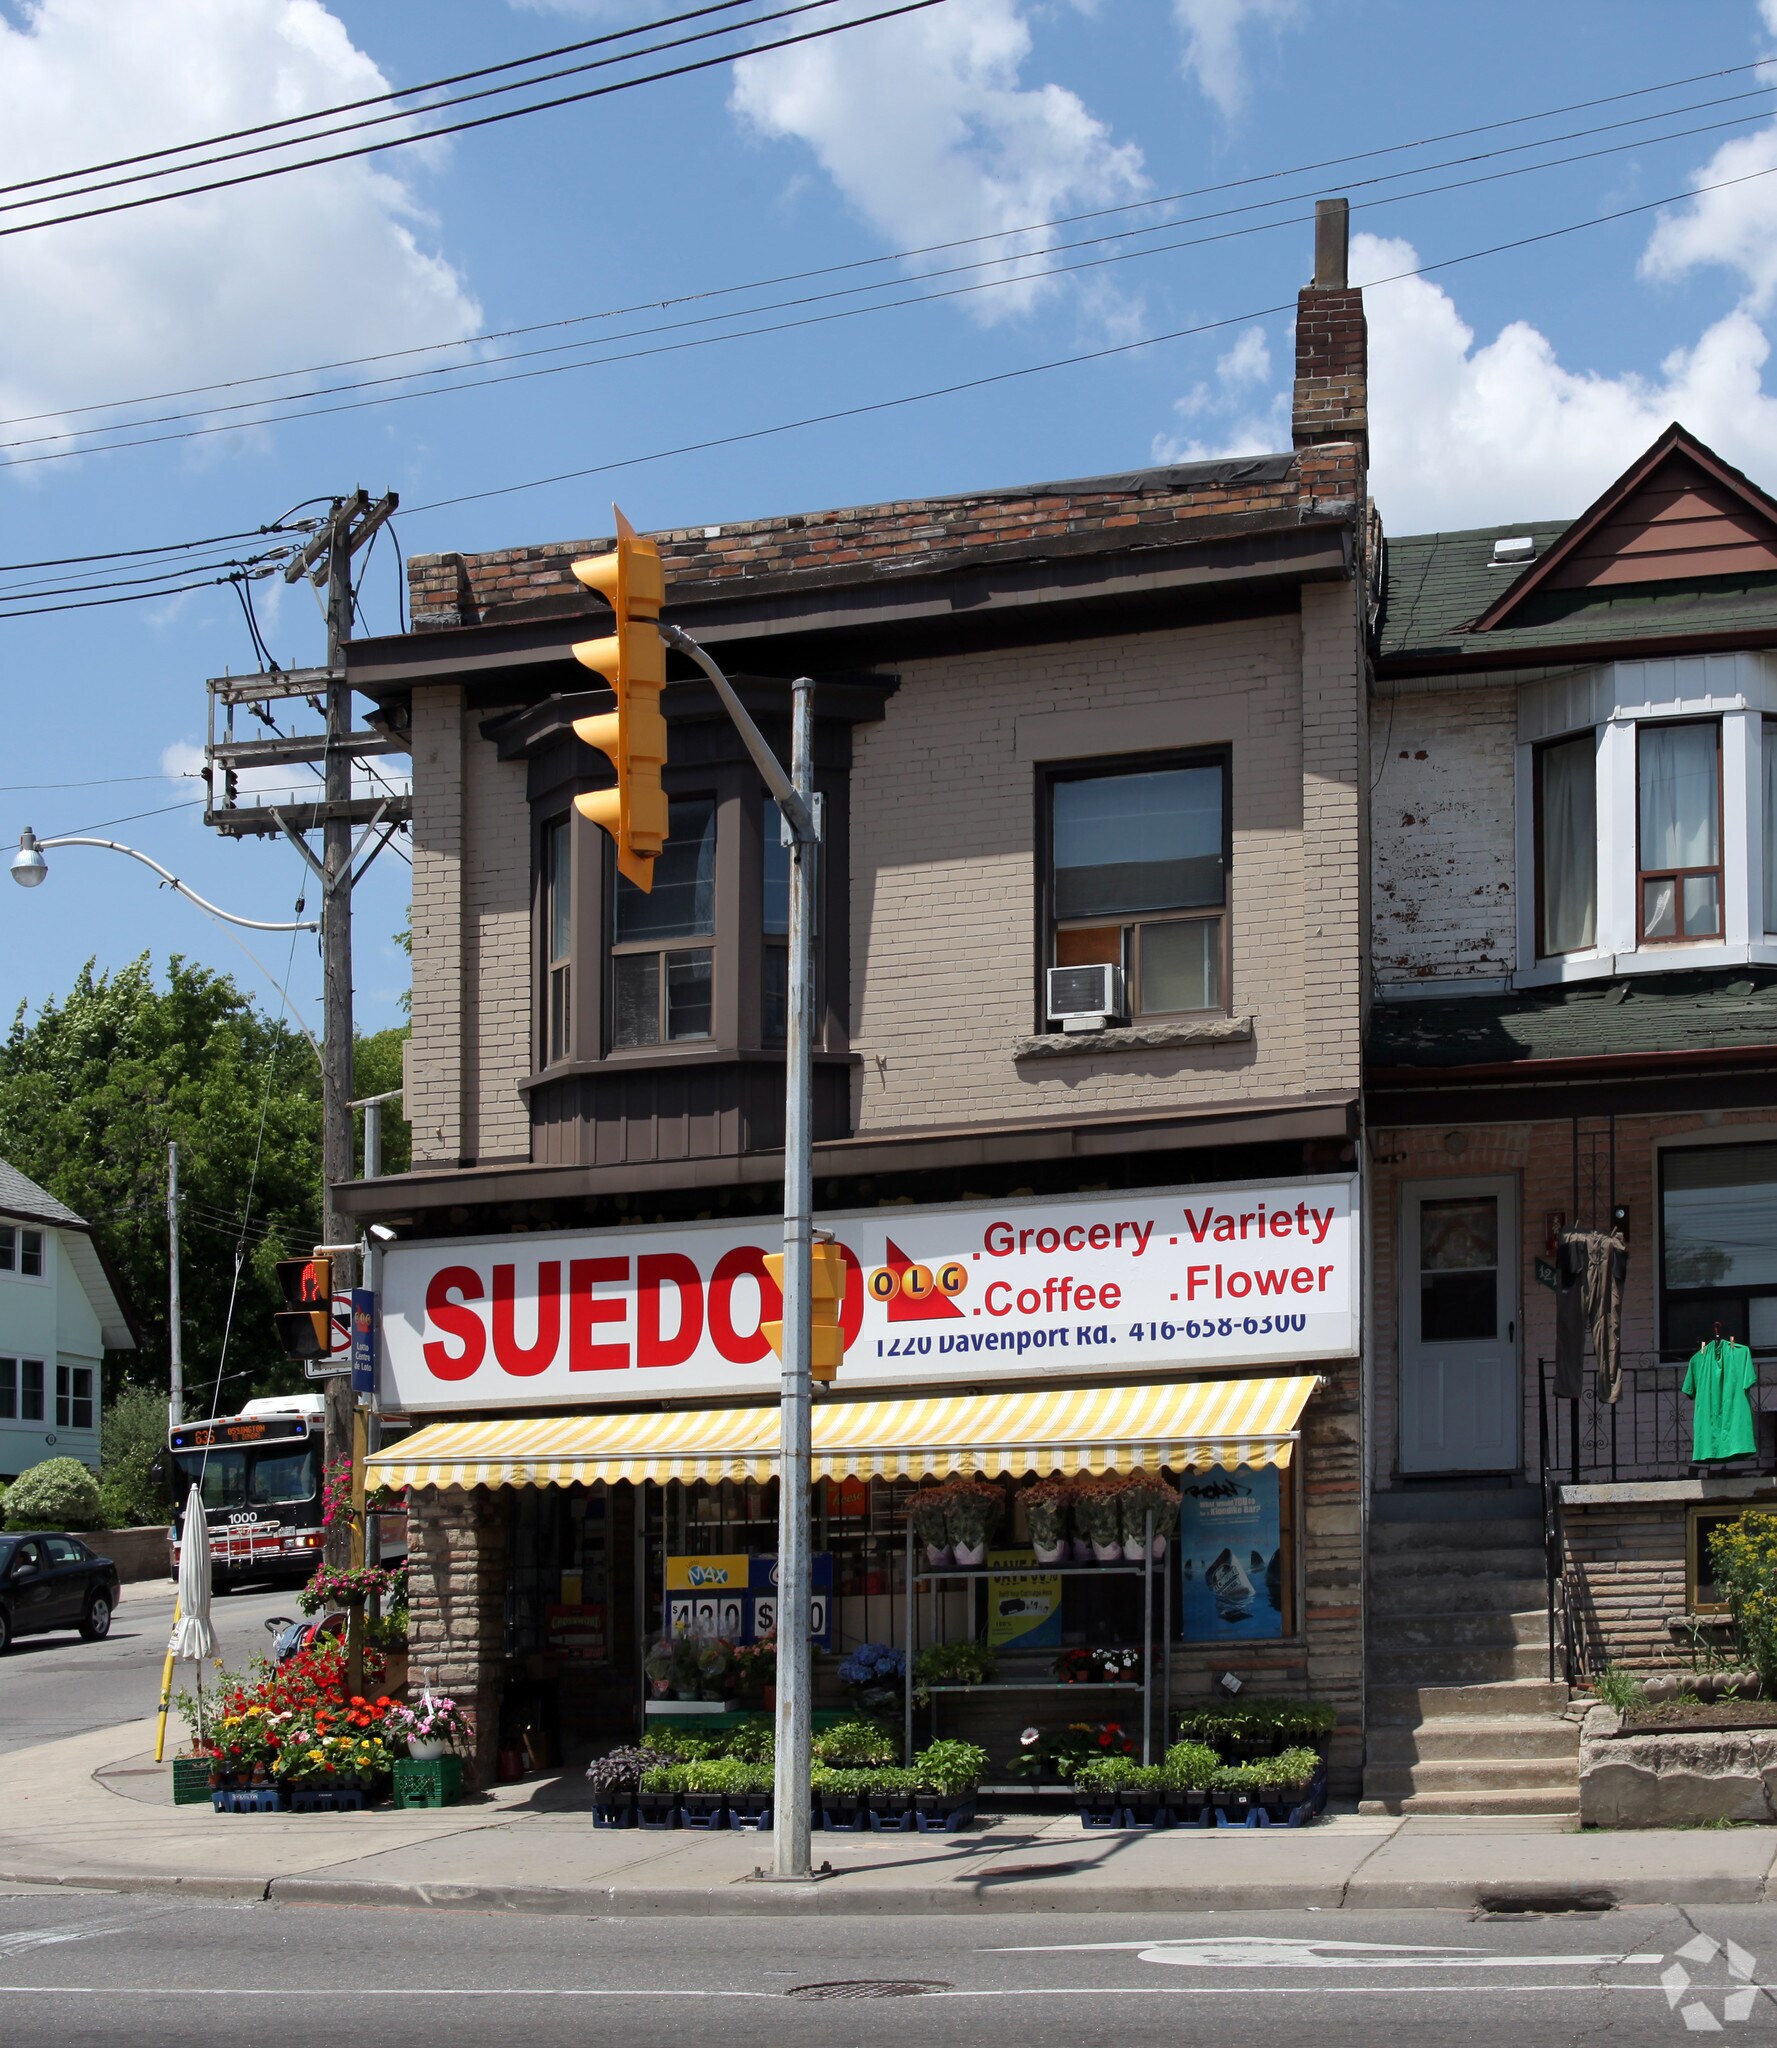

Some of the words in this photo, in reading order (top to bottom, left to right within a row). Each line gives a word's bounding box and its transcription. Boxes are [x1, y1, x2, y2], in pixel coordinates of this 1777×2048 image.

[873, 1266, 961, 1297] OLG
[877, 1337, 932, 1357] 1220
[939, 1327, 1070, 1355] Davenport
[1077, 1325, 1117, 1346] Rd.
[1128, 1313, 1307, 1341] 416-658-6300
[228, 1512, 257, 1524] 1000
